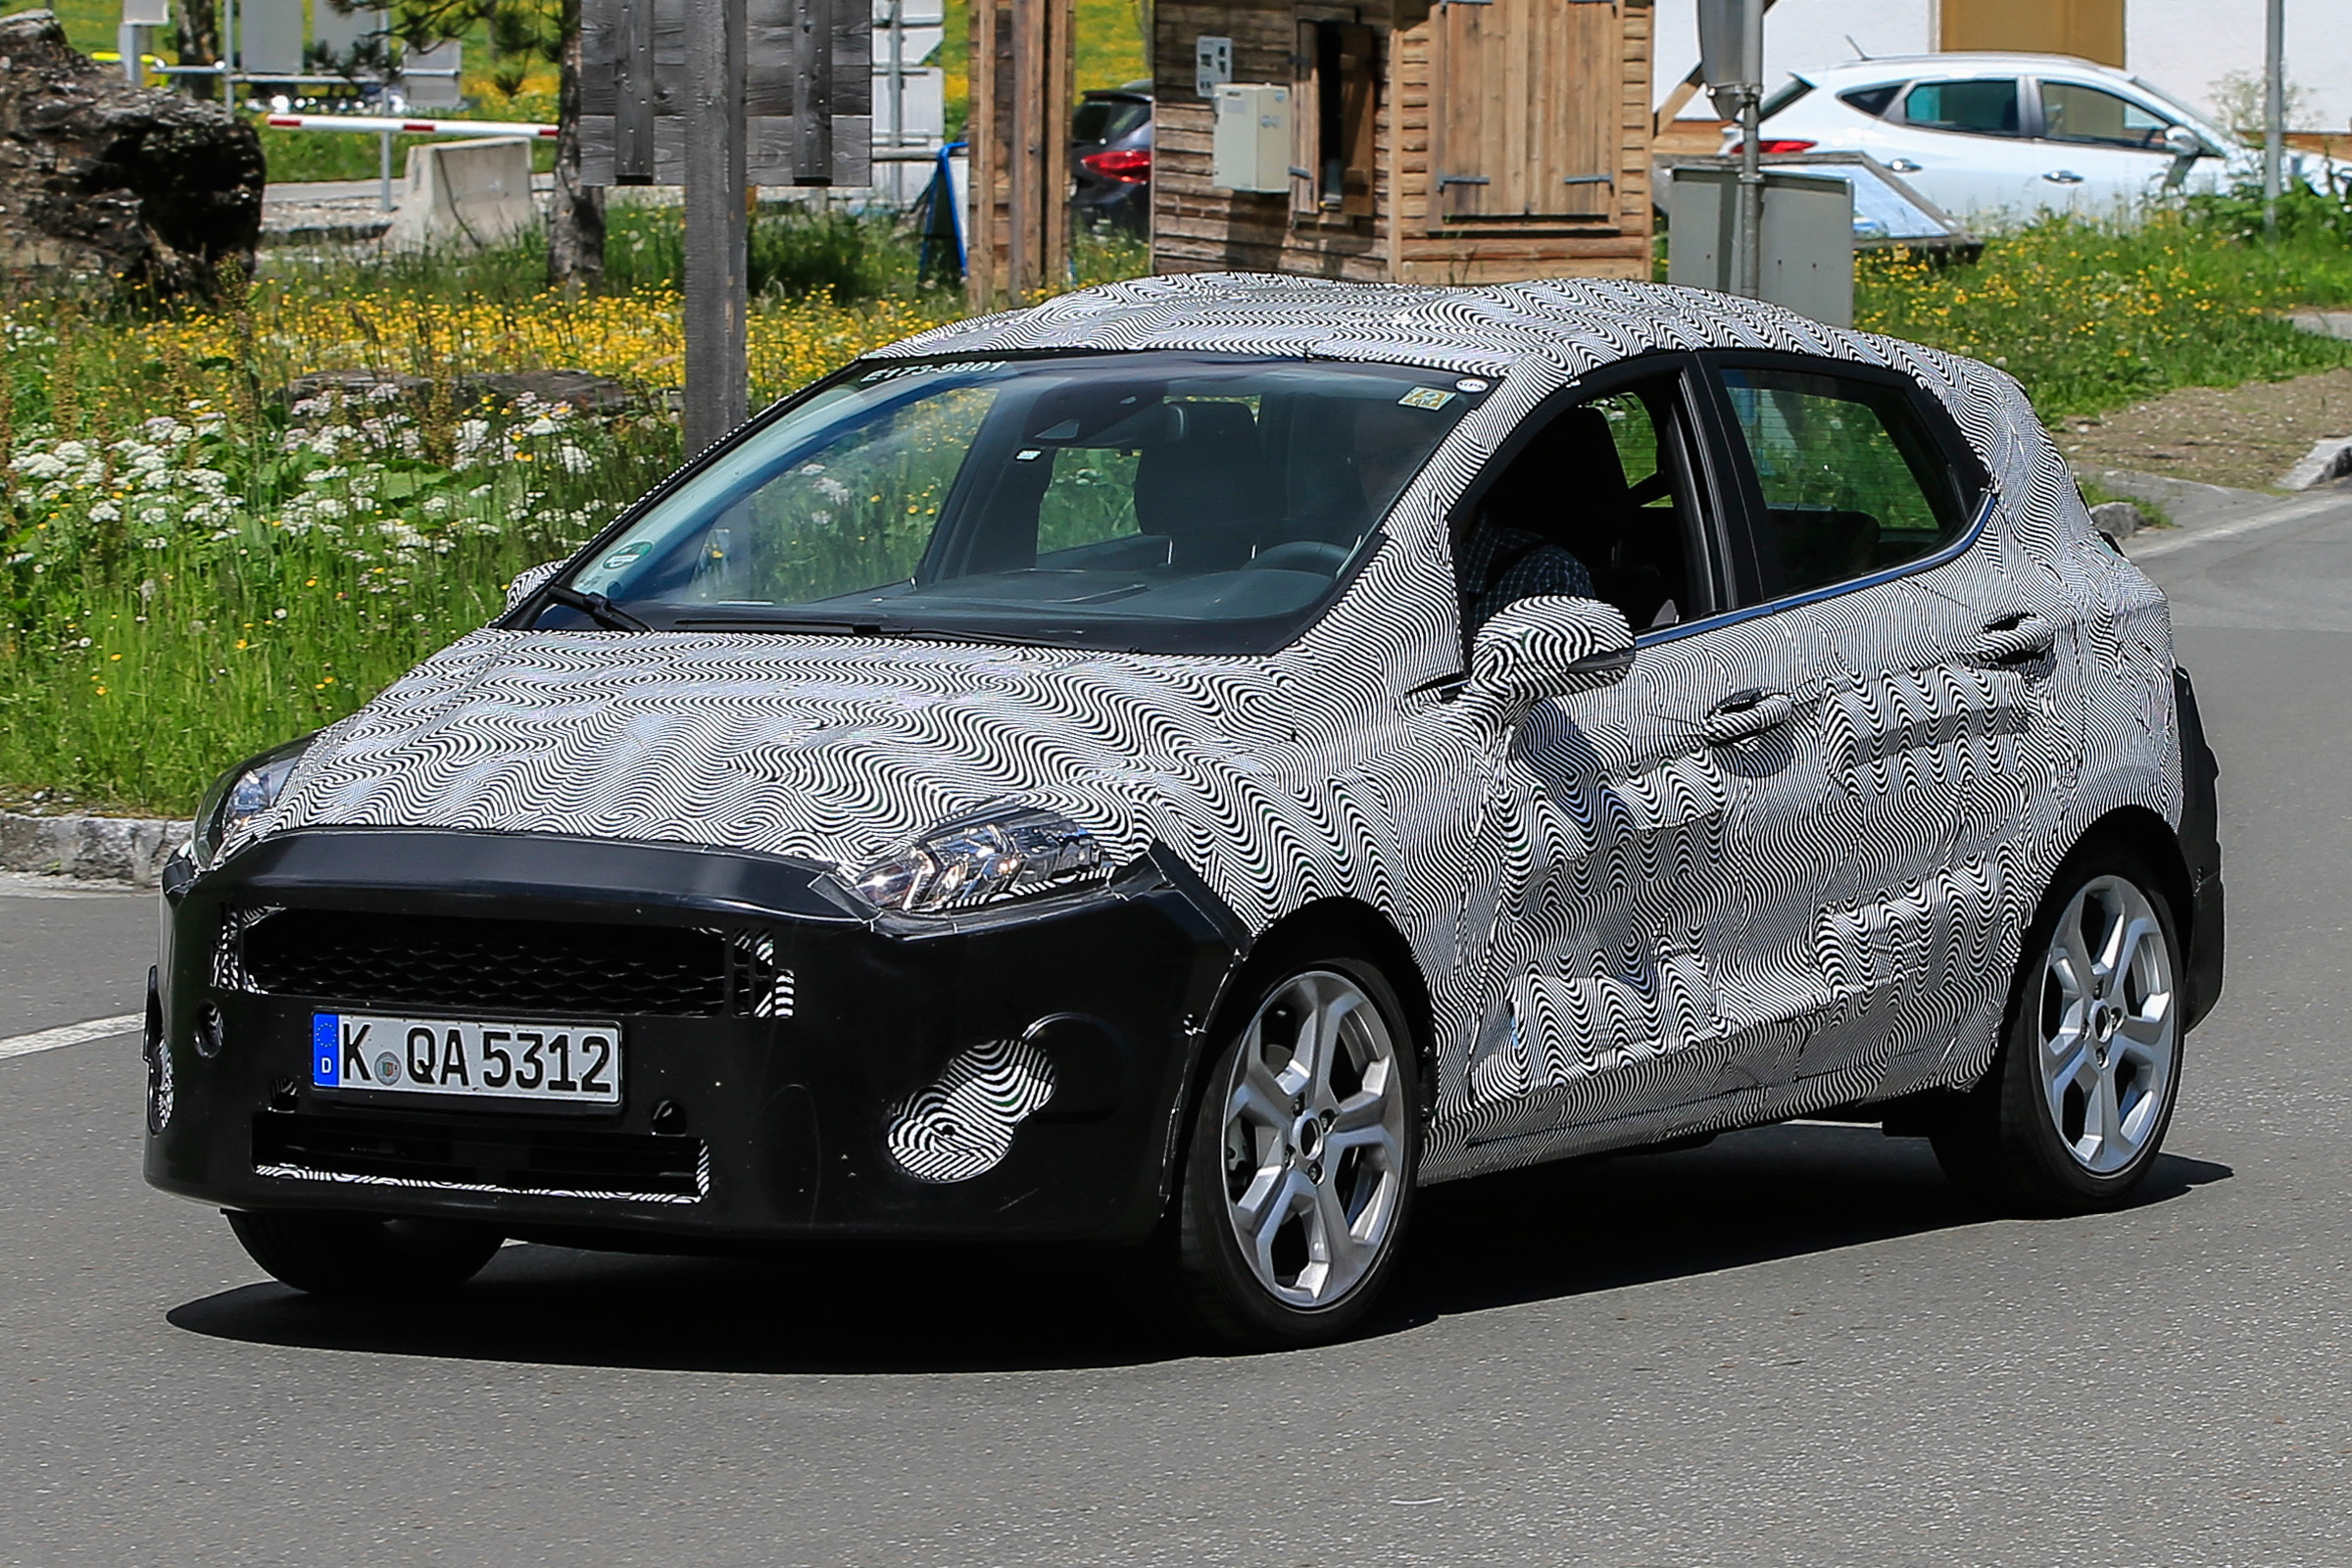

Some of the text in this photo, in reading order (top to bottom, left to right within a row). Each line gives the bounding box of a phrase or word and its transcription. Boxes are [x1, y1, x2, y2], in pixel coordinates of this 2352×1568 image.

[321, 1057, 332, 1074] D
[343, 1023, 371, 1081] K
[407, 1026, 470, 1087] QA
[482, 1031, 612, 1094] 5312
